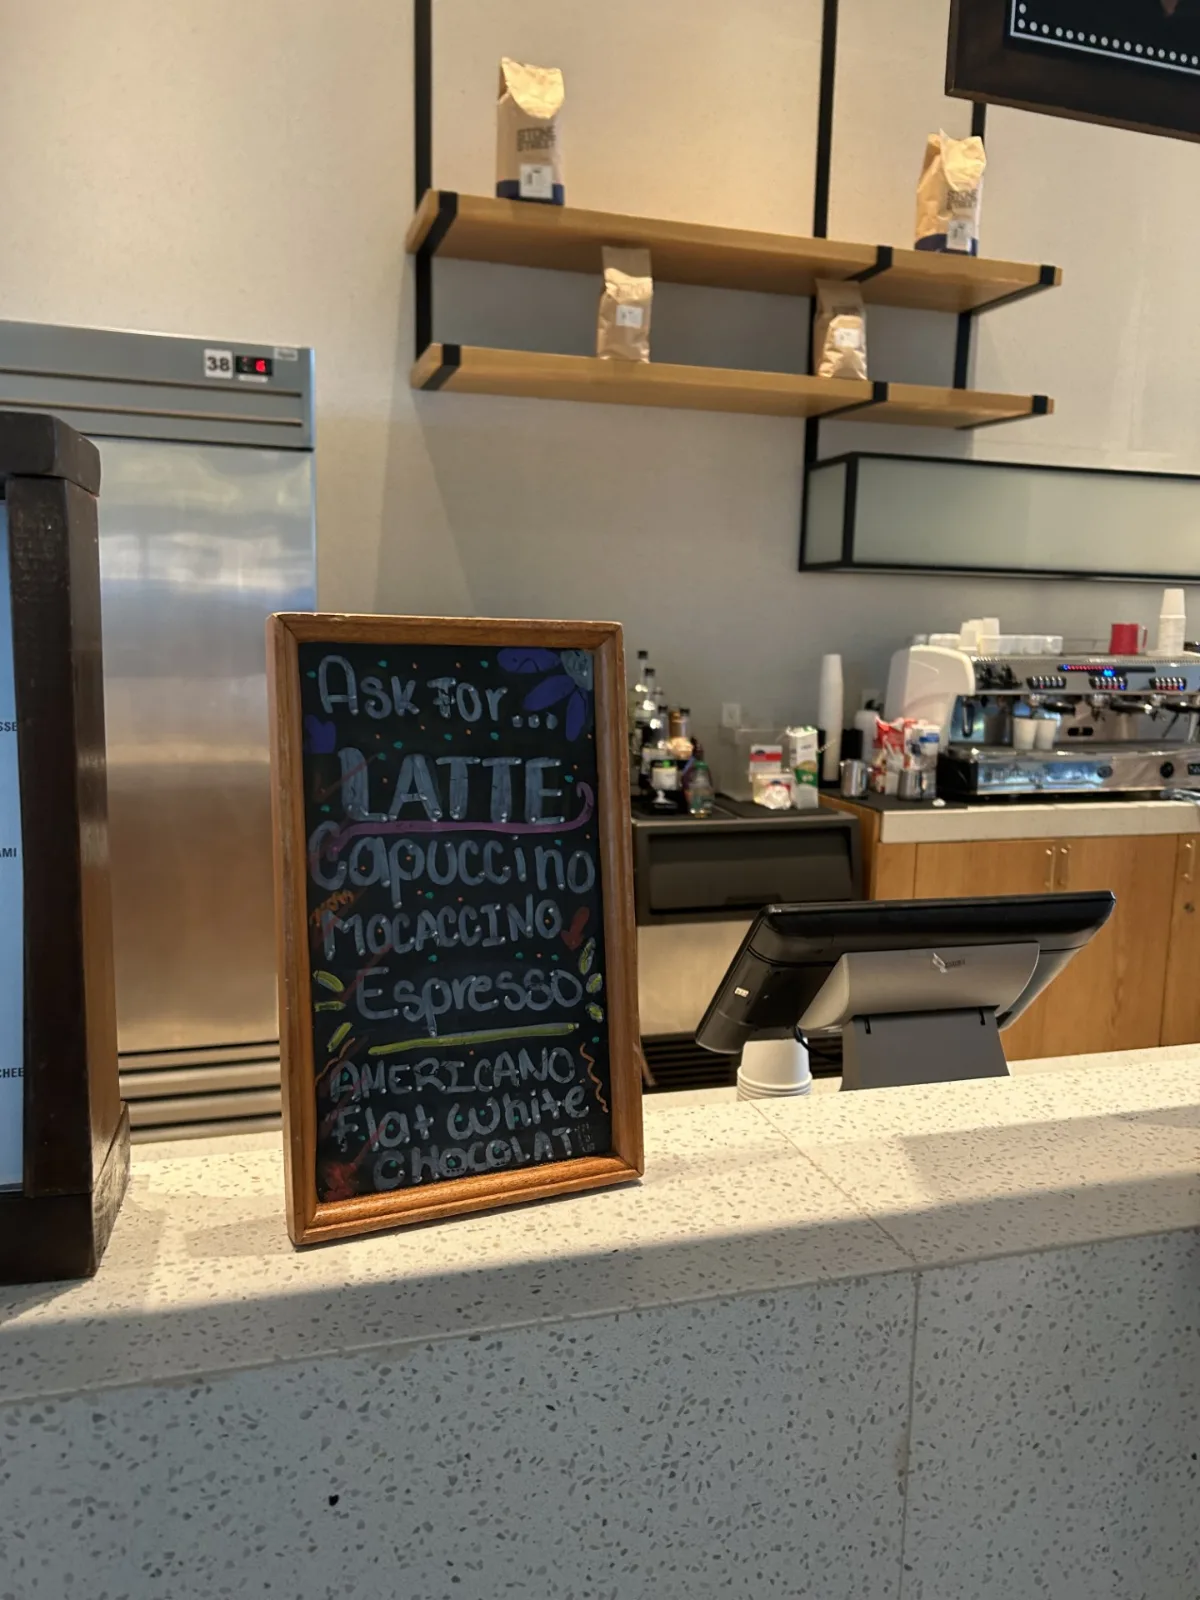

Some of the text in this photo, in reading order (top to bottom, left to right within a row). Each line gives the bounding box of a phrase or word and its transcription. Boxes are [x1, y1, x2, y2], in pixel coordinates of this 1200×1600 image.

[207, 356, 230, 372] 38
[337, 747, 566, 824] LATTE
[0, 847, 17, 858] MI
[309, 820, 597, 909] Capuccino
[321, 894, 563, 961] MOCACCINO
[356, 968, 584, 1038] Espresso
[0, 1067, 24, 1078] HEE
[329, 1047, 576, 1102] AMERICANO
[326, 1103, 435, 1152] Flat
